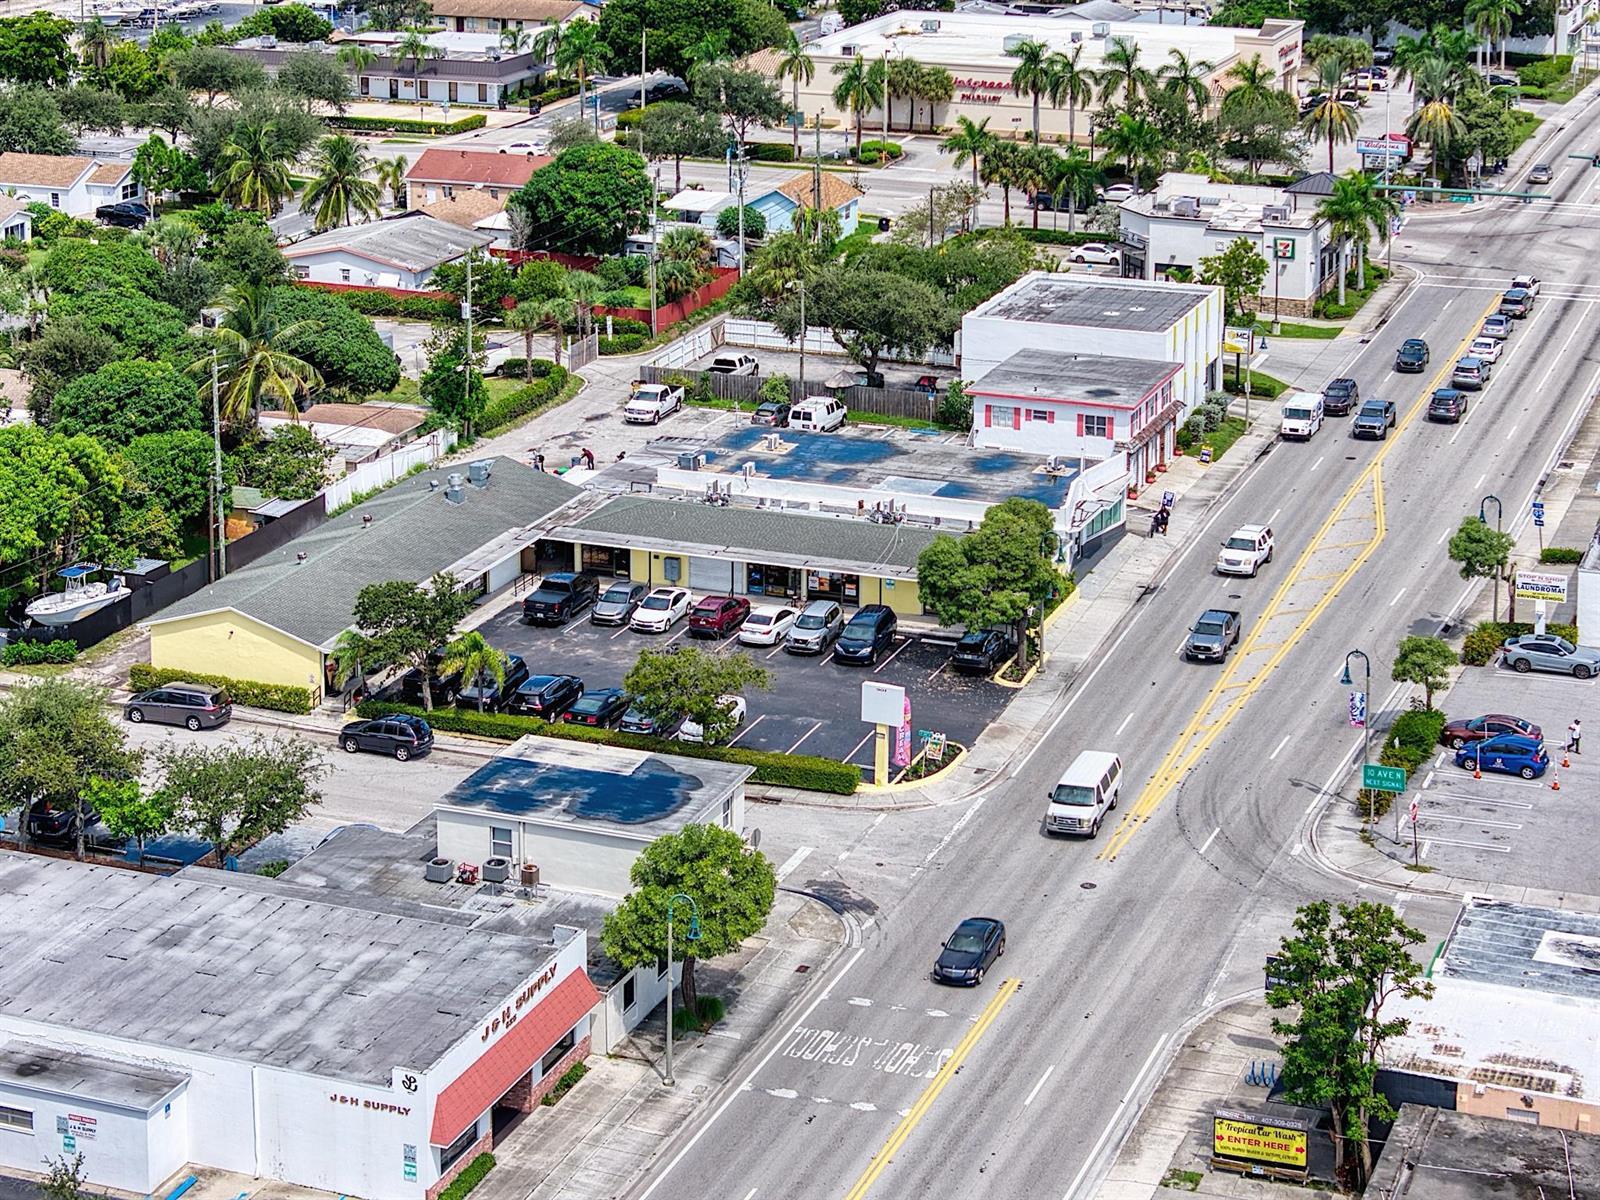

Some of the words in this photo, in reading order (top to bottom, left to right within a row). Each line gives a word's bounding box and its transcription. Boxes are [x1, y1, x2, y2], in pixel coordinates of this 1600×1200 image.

[1516, 584, 1566, 594] LAUNDROMAT
[1365, 778, 1380, 786] NEXT
[1382, 780, 1403, 789] SIGNAL
[1377, 770, 1393, 779] AVE
[1395, 772, 1402, 780] N
[481, 1025, 490, 1042] J
[502, 1006, 511, 1024] H
[515, 962, 558, 1010] SUPPLY
[330, 1094, 337, 1102] J
[350, 1097, 359, 1106] H
[363, 1099, 411, 1116] SUPPLY
[1225, 1122, 1256, 1136] Tropical
[1257, 1126, 1271, 1137] Car
[1273, 1130, 1296, 1141] Wash
[1227, 1135, 1261, 1148] ENTER
[1263, 1141, 1291, 1152] HERE
